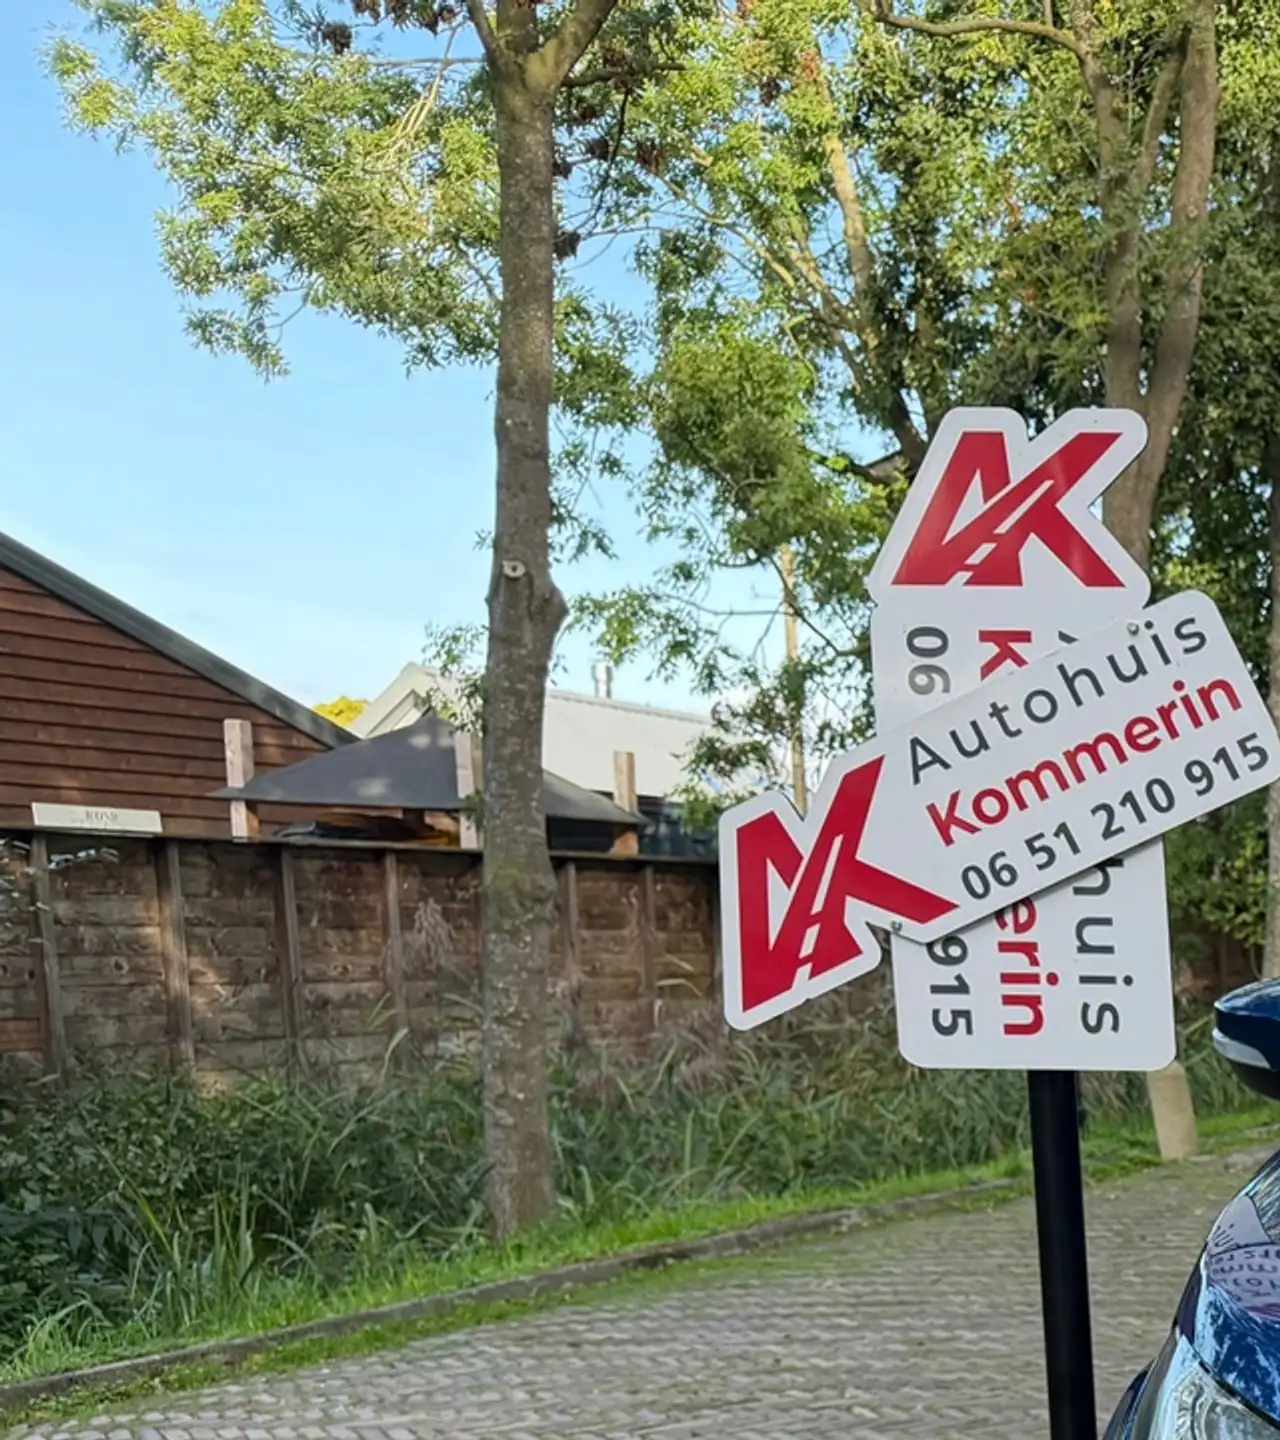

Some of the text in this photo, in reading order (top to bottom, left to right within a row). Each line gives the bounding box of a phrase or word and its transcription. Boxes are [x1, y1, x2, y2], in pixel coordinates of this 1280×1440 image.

[909, 617, 1207, 785] Autohuis
[926, 679, 1242, 847] Kommerin
[905, 626, 973, 1036] 06 915
[961, 733, 1269, 900] 06 51 210 915
[978, 630, 1059, 1036] K erin
[1072, 858, 1134, 1035] huis
